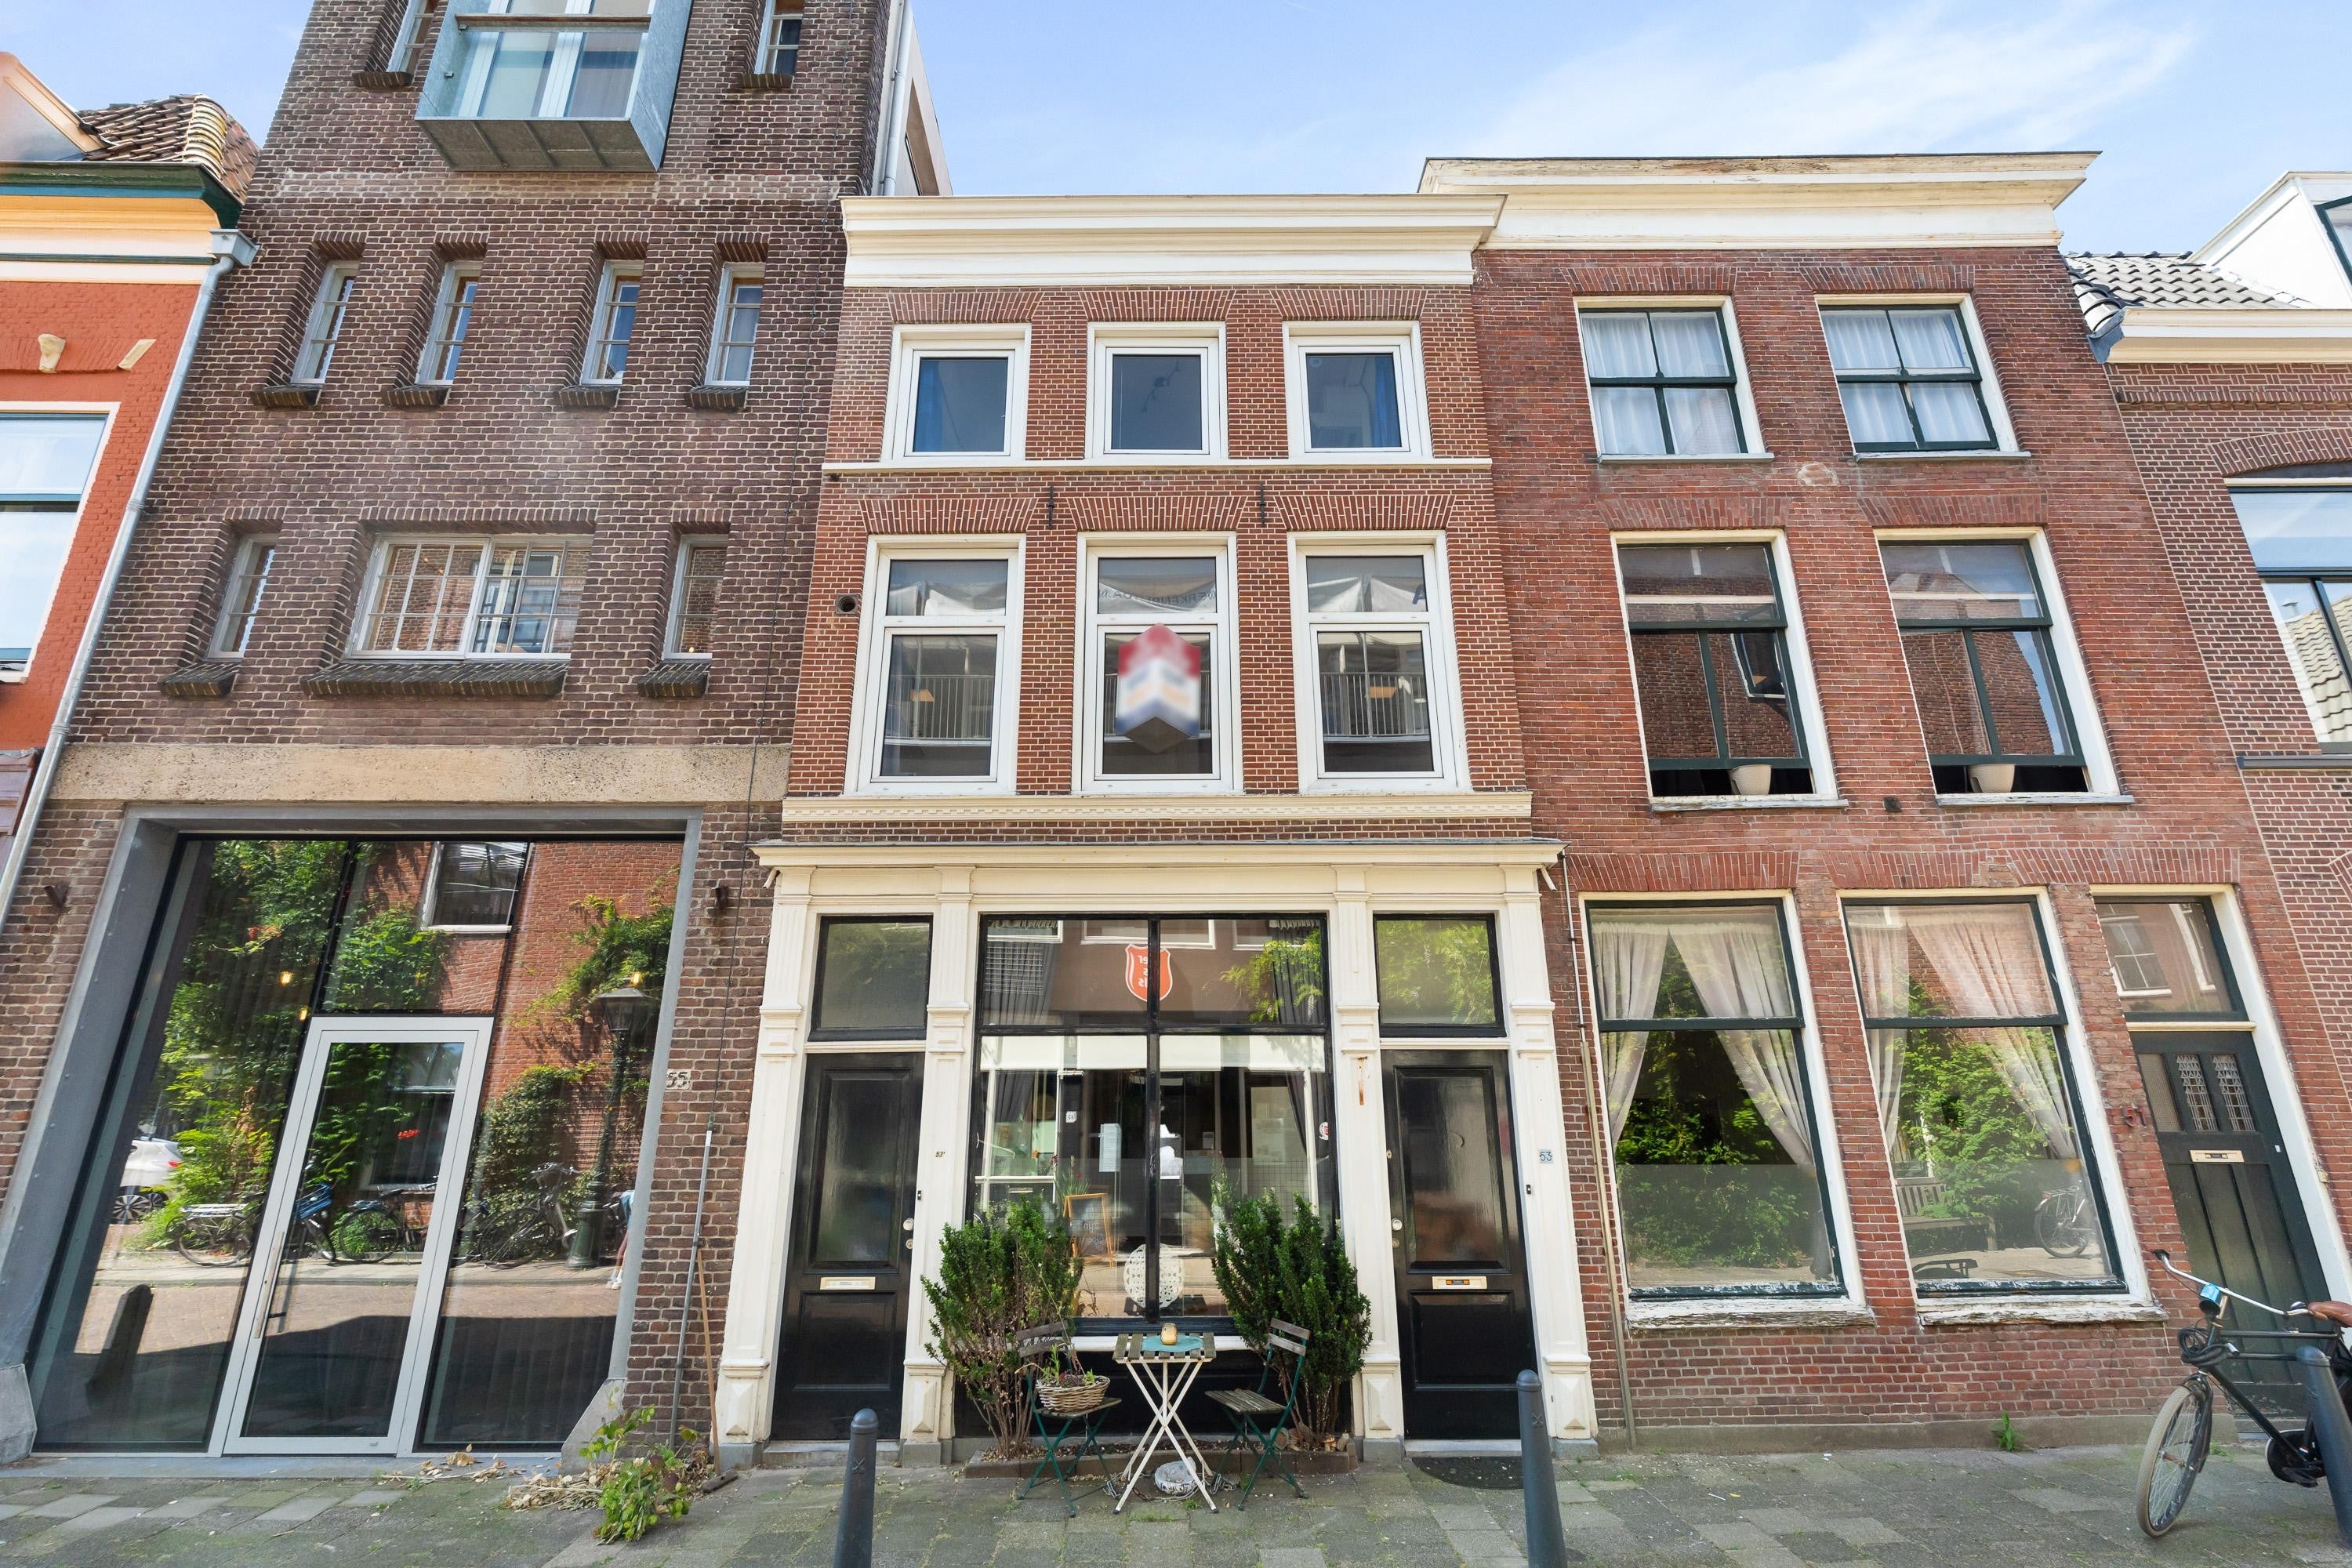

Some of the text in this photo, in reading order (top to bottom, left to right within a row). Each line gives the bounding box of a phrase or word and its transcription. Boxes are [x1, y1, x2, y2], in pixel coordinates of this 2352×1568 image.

[666, 1071, 688, 1088] 55
[2125, 1106, 2147, 1127] 51
[1539, 1151, 1553, 1161] 53
